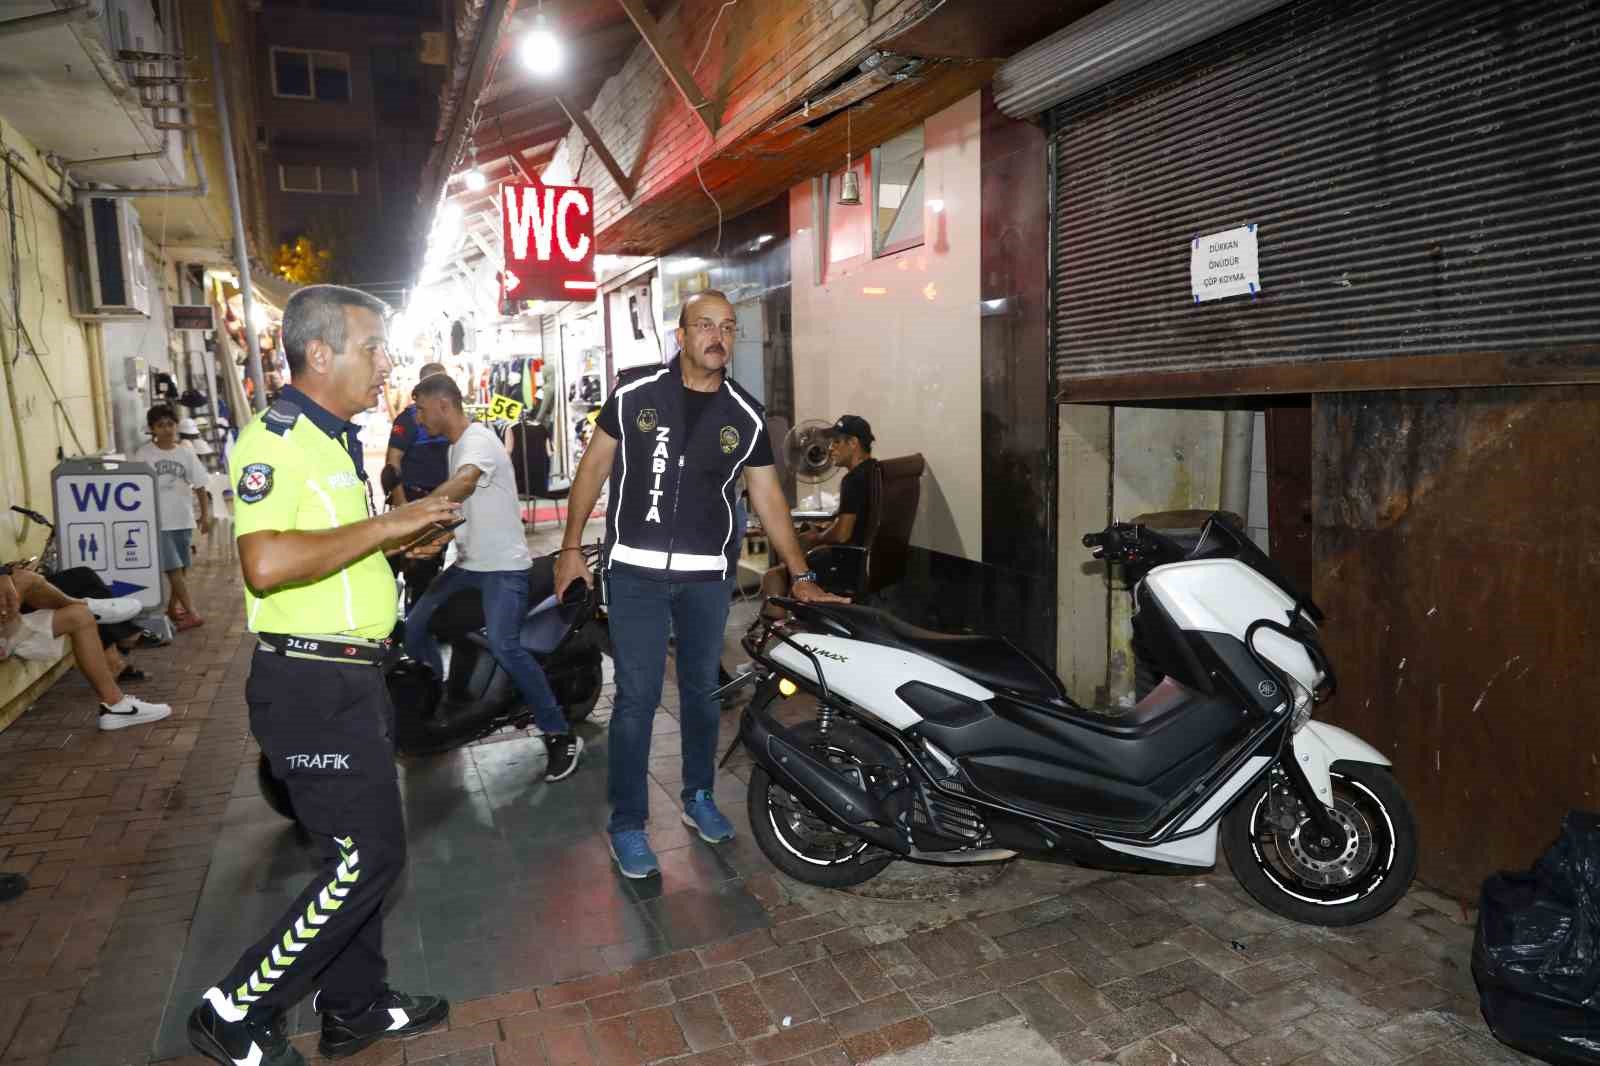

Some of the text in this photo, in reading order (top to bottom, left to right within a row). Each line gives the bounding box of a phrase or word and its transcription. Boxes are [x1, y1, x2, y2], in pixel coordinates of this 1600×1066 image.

[504, 186, 590, 262] WC
[1209, 239, 1239, 253] DÜKKAN
[1208, 255, 1240, 270] ÖNÜDÜR
[1219, 272, 1246, 284] KOYMA
[492, 397, 519, 420] 5€
[645, 426, 671, 524] ZABITA
[70, 481, 142, 512] WC
